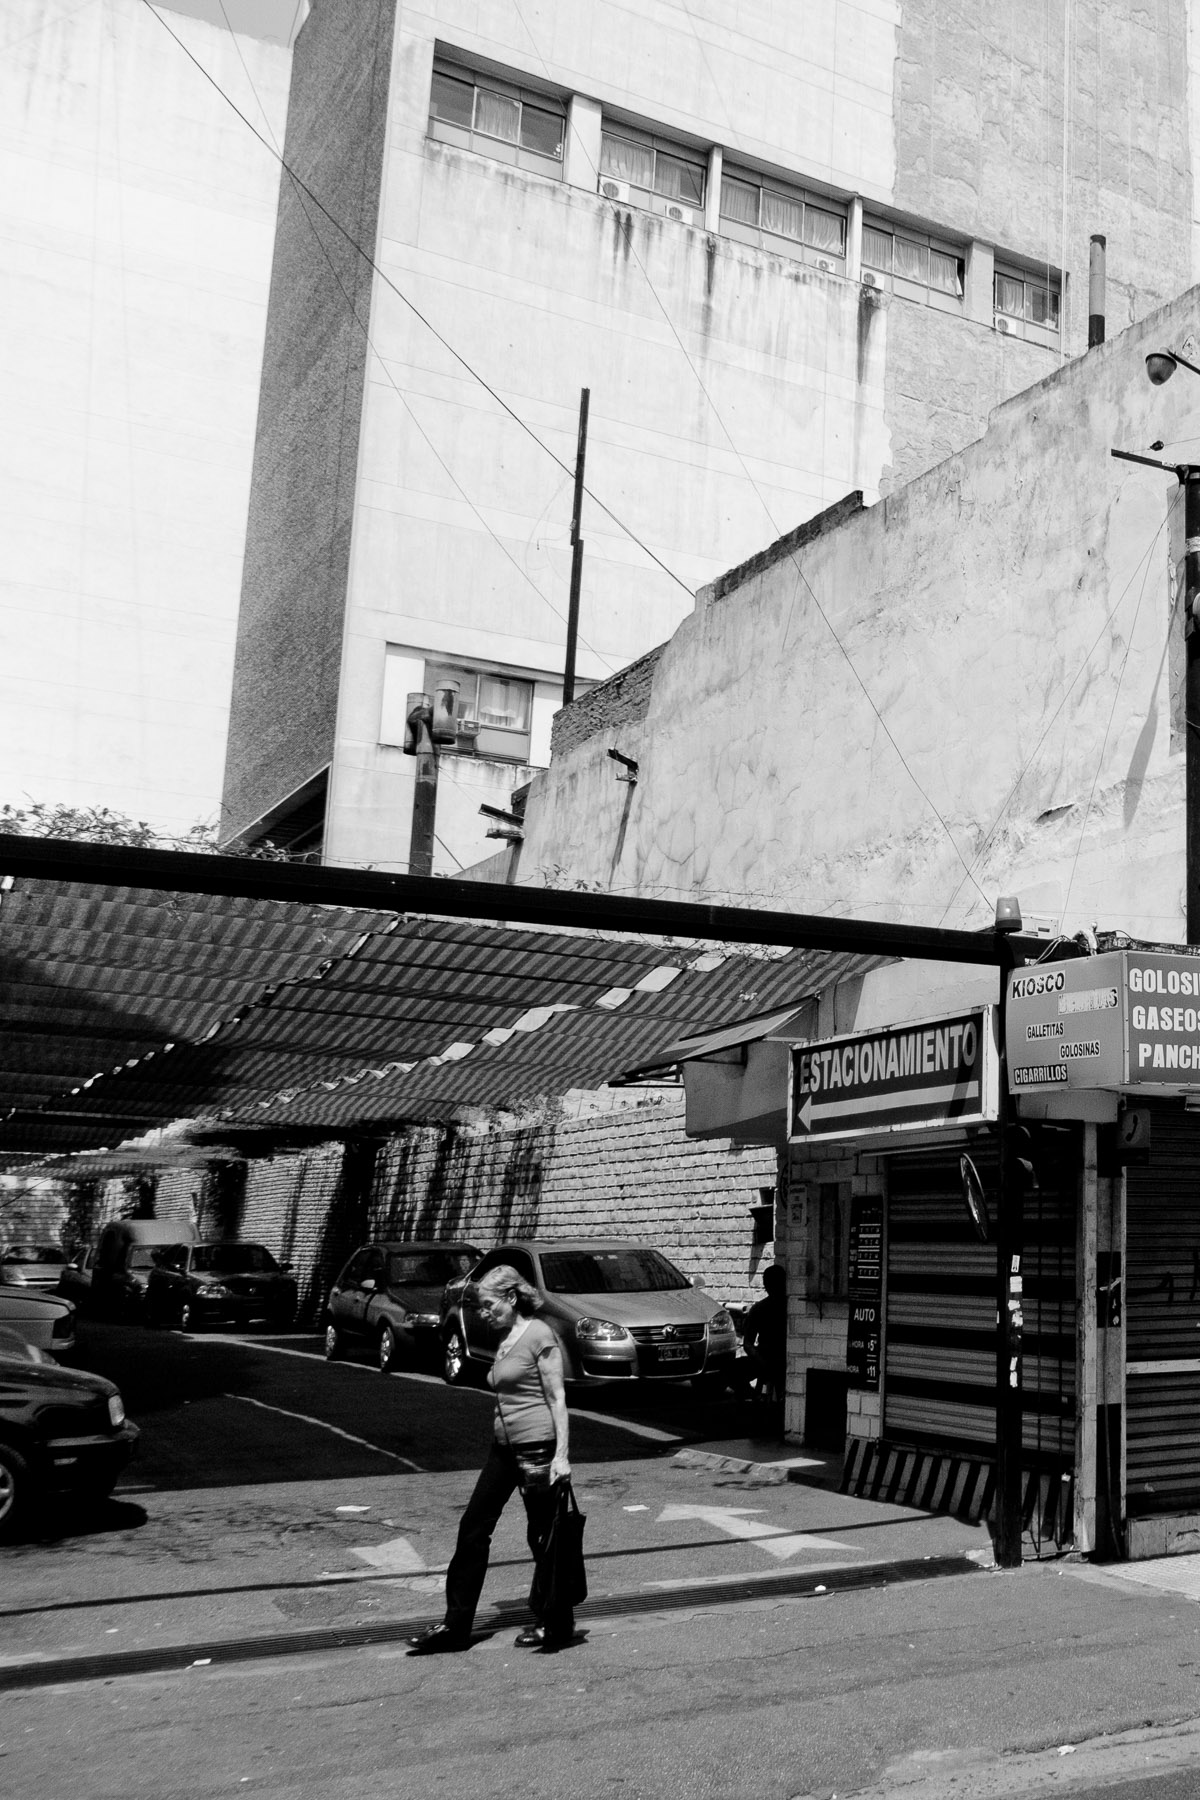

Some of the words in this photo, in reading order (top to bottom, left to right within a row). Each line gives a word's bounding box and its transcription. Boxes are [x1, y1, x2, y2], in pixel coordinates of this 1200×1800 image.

[1012, 972, 1065, 999] KIOSCO
[1027, 1022, 1064, 1039] GALLETITAS
[800, 1021, 977, 1094] ESTACIONAMIENTO
[1060, 1042, 1100, 1058] GOLOSINAS
[1014, 1065, 1067, 1084] CIGARRILLOS
[853, 1308, 876, 1322] AUTO
